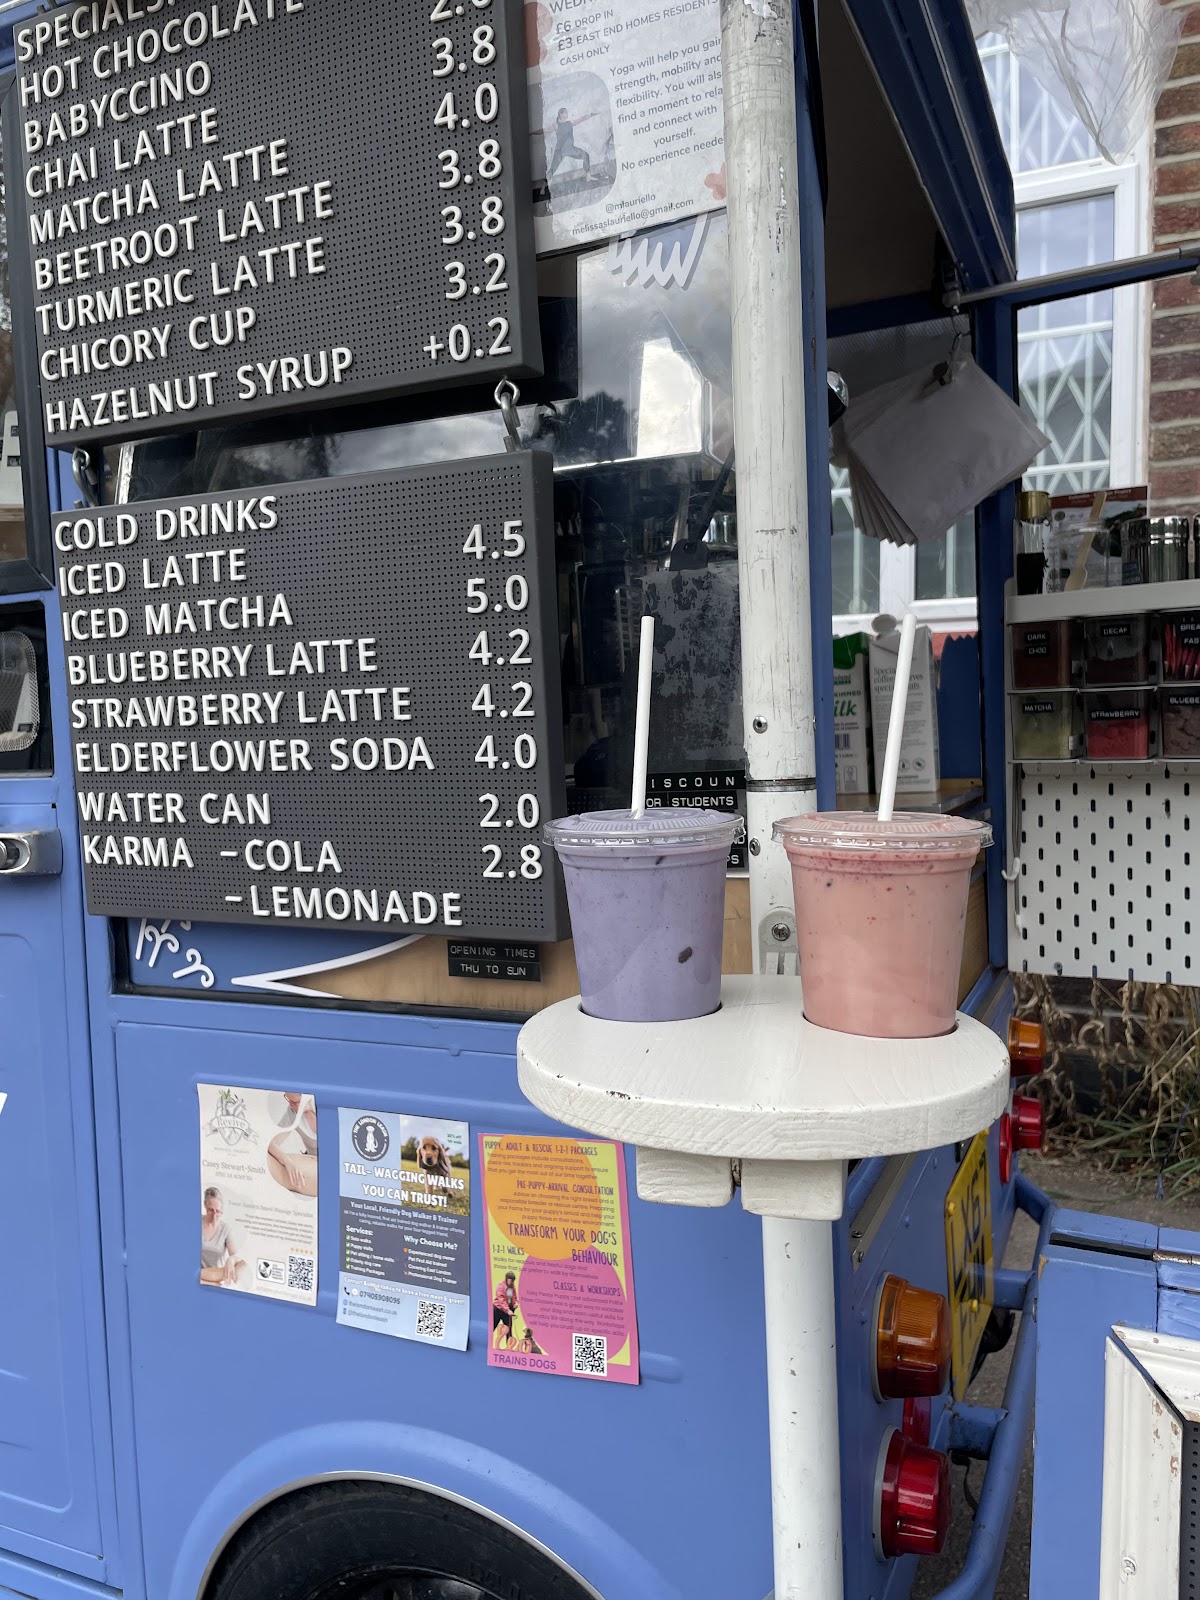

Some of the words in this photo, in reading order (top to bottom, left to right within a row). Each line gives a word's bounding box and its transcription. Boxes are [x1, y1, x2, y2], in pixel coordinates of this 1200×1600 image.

[556, 20, 572, 35] £6
[574, 14, 601, 28] DROP
[603, 9, 614, 19] IN
[576, 30, 601, 45] EAST
[603, 24, 623, 37] END
[625, 13, 661, 30] HOMES
[559, 53, 584, 66] CASH
[586, 45, 610, 58] ONLY
[610, 64, 635, 77] Yoga
[637, 57, 654, 70] will
[657, 50, 679, 65] help
[681, 44, 700, 58] you
[20, 56, 83, 107] HOT
[24, 60, 212, 153] BABYCCINO
[429, 0, 491, 22] 2.
[614, 74, 659, 92] strength,
[661, 60, 701, 80] mobility
[615, 89, 663, 108] flexibility.
[664, 81, 685, 94] You
[687, 74, 705, 87] will
[707, 70, 722, 82] als
[25, 146, 98, 199] CHAI
[113, 107, 220, 172] LATTE
[431, 25, 496, 77] 3.8
[617, 111, 637, 124] find
[639, 110, 646, 118] a
[648, 98, 689, 115] moment
[691, 92, 702, 102] to
[704, 87, 724, 99] rela
[632, 123, 651, 136] and
[653, 113, 692, 130] connect
[694, 105, 718, 118] with
[653, 128, 696, 148] yourself.
[29, 180, 160, 246] MATCHA
[176, 139, 290, 203] LATTE
[433, 83, 500, 132] 4.0
[621, 161, 635, 172] No
[638, 146, 691, 167] experience
[693, 135, 724, 152] neede
[34, 216, 201, 292] BEETROOT
[217, 180, 335, 244] LATTE
[437, 139, 502, 189] 3.8
[36, 268, 195, 337] TURMERIC
[211, 237, 328, 297] LATTE
[440, 195, 505, 244] 3.8
[40, 323, 173, 383] CHICORY
[188, 307, 257, 351] CUP
[443, 253, 508, 301] 3.2
[45, 372, 219, 434] HAZELNUT
[236, 347, 354, 401] SYRUP
[422, 317, 512, 362] +0.2
[54, 514, 139, 552] COLD
[155, 496, 278, 541] DRINKS
[58, 560, 127, 597] ICED
[142, 548, 248, 591] LATTE
[462, 519, 527, 560] 4.5
[62, 606, 130, 642] ICED
[145, 592, 294, 636] MATCHA
[466, 574, 529, 614] 5.0
[1180, 623, 1200, 632] BREA
[67, 644, 254, 686] BLUEBERRY
[265, 637, 379, 677] LATTE
[468, 628, 534, 666] 4.2
[71, 690, 285, 730] STRAWBERRY
[298, 686, 413, 724] LATTE
[471, 680, 536, 719] 4.2
[834, 699, 856, 717] ilk
[1024, 703, 1052, 712] MATCHA
[1169, 696, 1200, 704] BLUEBE
[1090, 710, 1140, 719] STRAWBERRY
[75, 739, 313, 773] ELDERFLOWER
[330, 736, 436, 772] SODA
[474, 733, 538, 771] 4.0
[651, 776, 735, 789] ISCOUN
[77, 791, 187, 824] WATER
[199, 792, 272, 825] CAN
[477, 792, 541, 830] 2.0
[645, 798, 662, 808] OR
[671, 796, 734, 807] STUDENTS
[82, 834, 195, 869] KARMA
[481, 843, 544, 880] 2.8
[450, 945, 496, 956] OPENING
[504, 948, 536, 958] TIMES
[460, 964, 480, 973] THU
[486, 965, 499, 974] TO
[506, 966, 526, 976] SUN
[216, 1117, 246, 1129] Revive
[485, 1140, 503, 1150] PUPPY,
[506, 1142, 522, 1151] ADULT
[532, 1144, 552, 1153] RESCUE
[555, 1146, 568, 1154] 1-2-1
[571, 1146, 598, 1156] PACKAGES
[221, 1161, 266, 1175] Stewart-Smith
[374, 1166, 426, 1184] WAGGING
[427, 1173, 465, 1190] WALKS
[362, 1184, 385, 1198] YOU
[387, 1188, 408, 1202] CAN
[410, 1191, 448, 1208] TRUST!
[516, 1179, 569, 1193] PRE-PUPPY-ARRIVAL
[572, 1185, 614, 1196] CONSULTATION
[350, 1201, 363, 1209] Your
[363, 1204, 378, 1212] Local,
[379, 1205, 401, 1216] Friendly
[401, 1209, 412, 1218] Dog
[412, 1210, 432, 1220] Walker
[438, 1214, 459, 1225] Trainer
[345, 1224, 374, 1236] Services:
[508, 1222, 558, 1240] TRANSFORM
[563, 1228, 586, 1243] YOUR
[591, 1230, 617, 1246] DOG'S
[404, 1234, 418, 1246] Why
[419, 1237, 443, 1249] Choose
[443, 1241, 458, 1251] Me?
[493, 1244, 505, 1254] 1-2-1
[507, 1246, 525, 1255] WALKS
[571, 1248, 619, 1267] BEHAVIOUR
[553, 1280, 577, 1292] CLASSES
[579, 1284, 584, 1292] &
[587, 1285, 621, 1297] WORKSHOPS
[493, 1353, 527, 1367] TRAINS
[529, 1358, 556, 1370] DOGS
